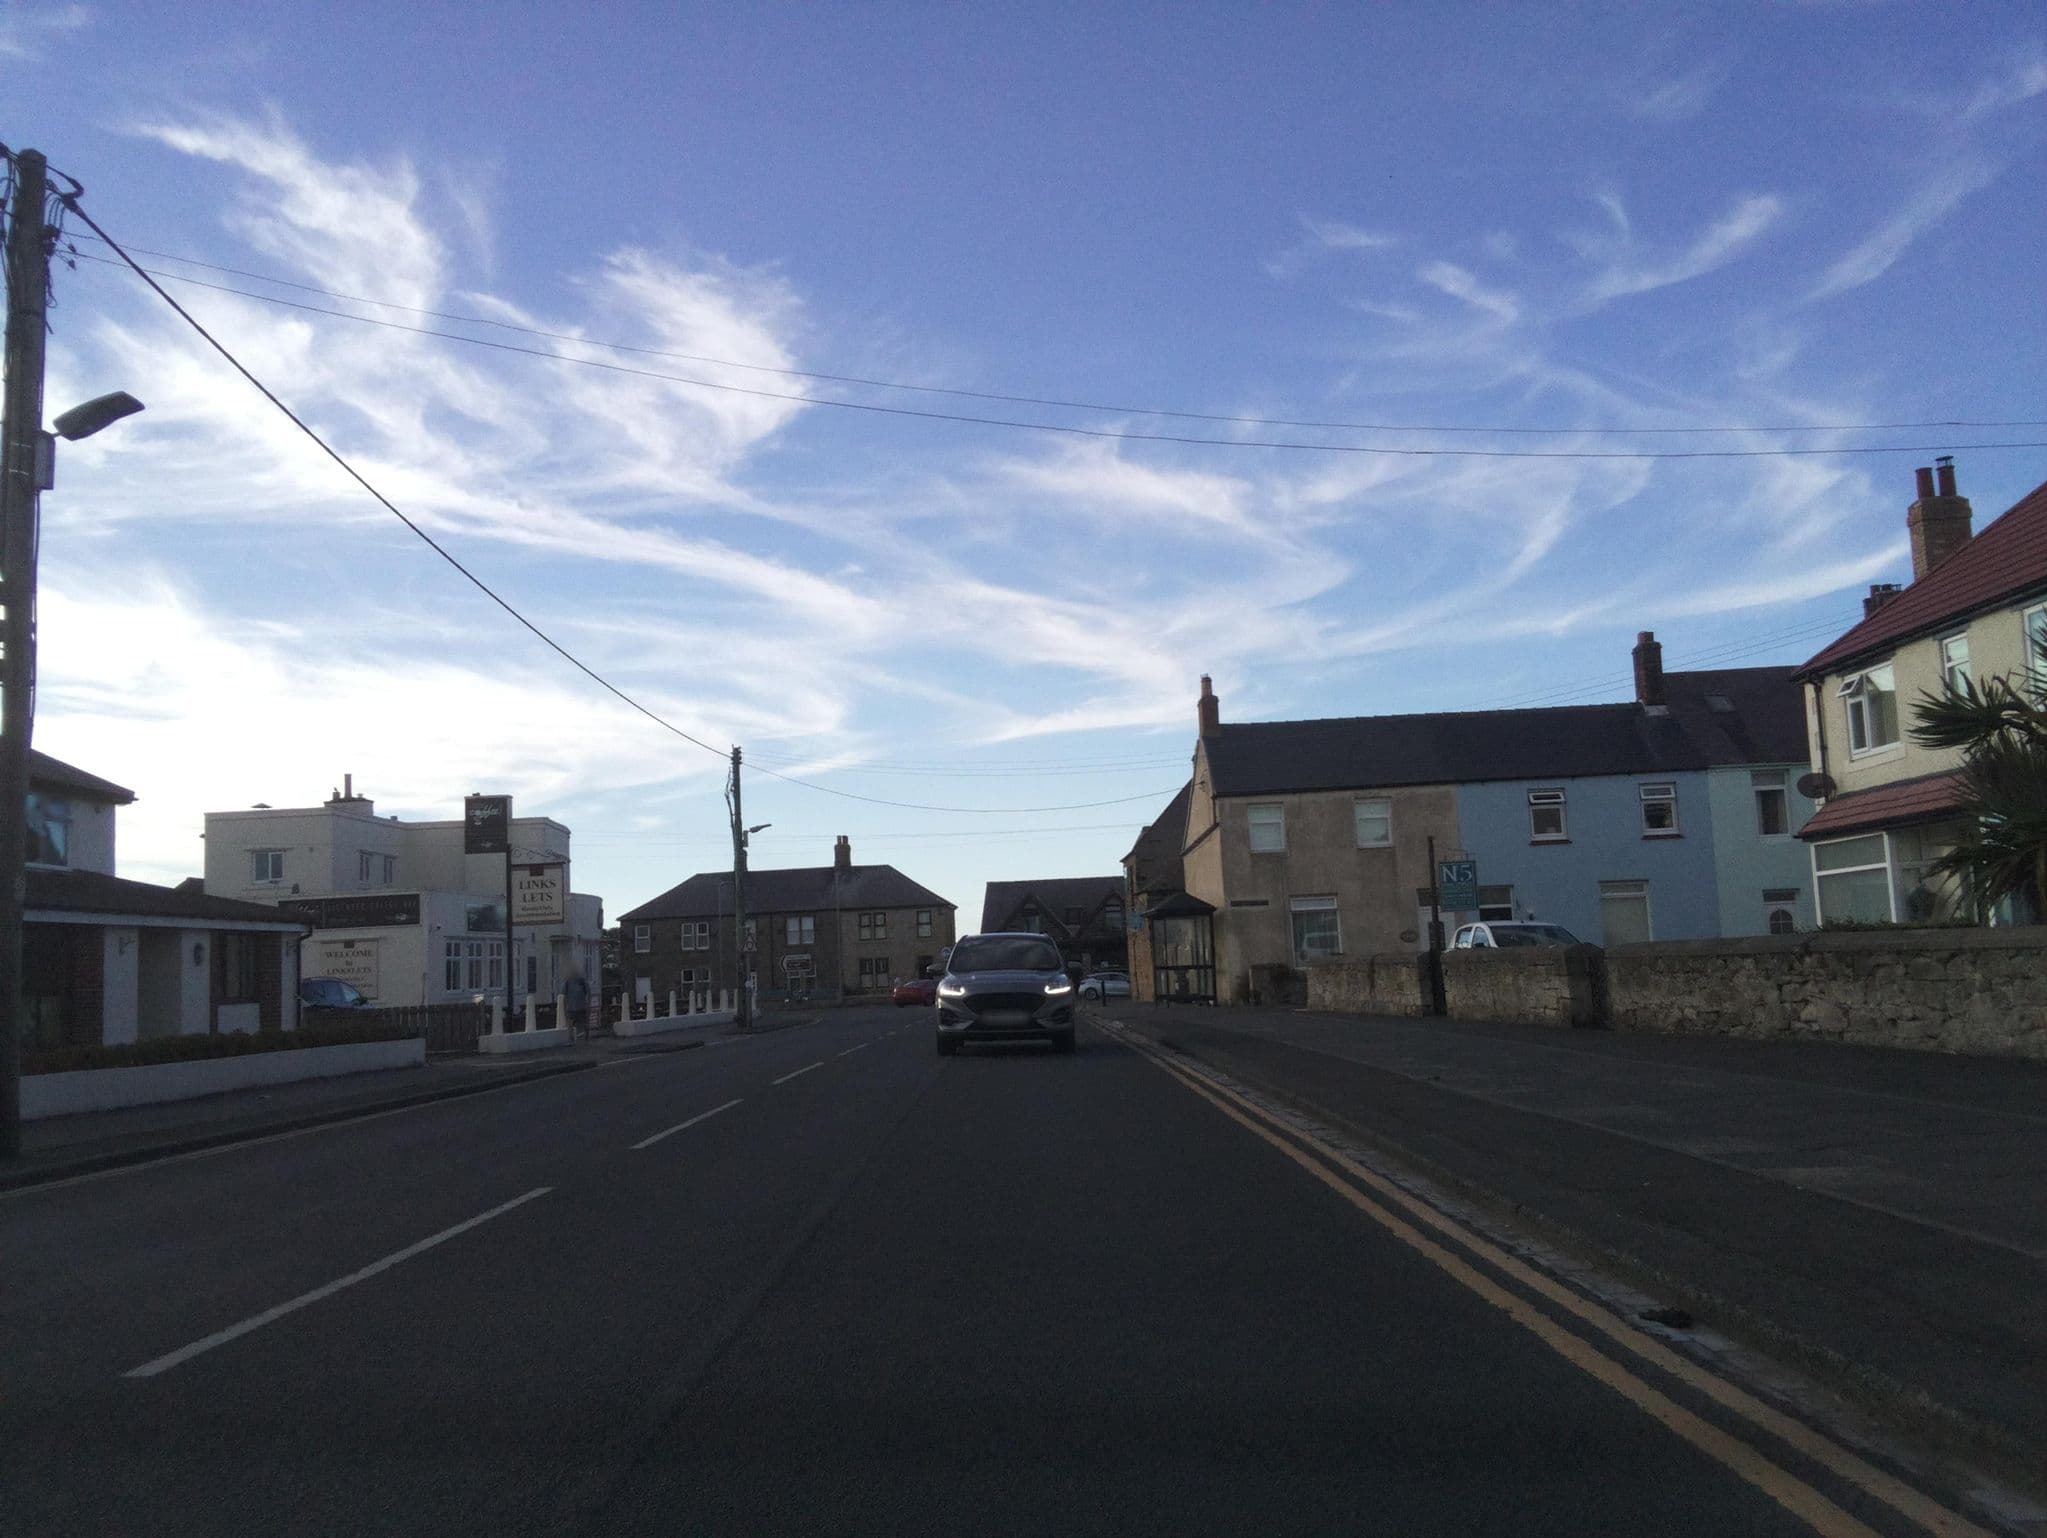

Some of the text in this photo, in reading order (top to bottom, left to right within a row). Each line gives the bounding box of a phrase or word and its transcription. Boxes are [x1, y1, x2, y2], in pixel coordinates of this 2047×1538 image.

[519, 879, 557, 890] LINKS
[522, 891, 553, 903] LETS
[324, 950, 374, 959] WELCOME
